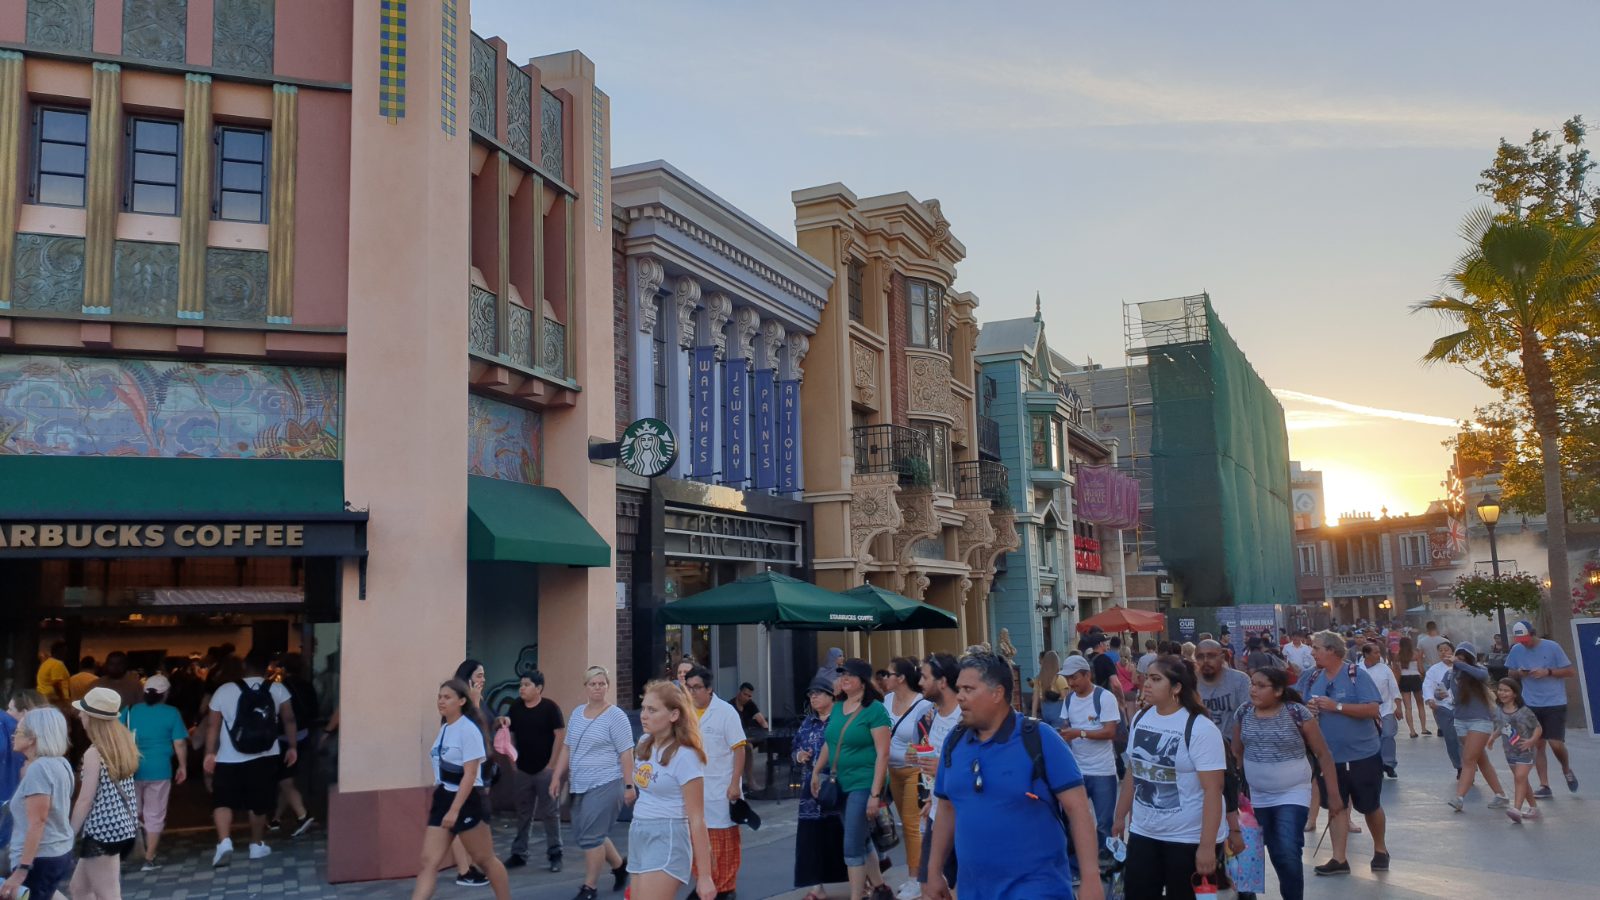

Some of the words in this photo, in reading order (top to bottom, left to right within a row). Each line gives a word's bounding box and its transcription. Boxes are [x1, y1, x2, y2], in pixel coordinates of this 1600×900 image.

[699, 360, 710, 463] WATCHES
[731, 372, 741, 469] JEWELRY
[784, 385, 793, 487] ANTIQUES
[174, 525, 304, 547] COFFEE
[689, 534, 729, 557] FINE
[741, 540, 779, 560] ARTS
[697, 514, 770, 538] PERKINS
